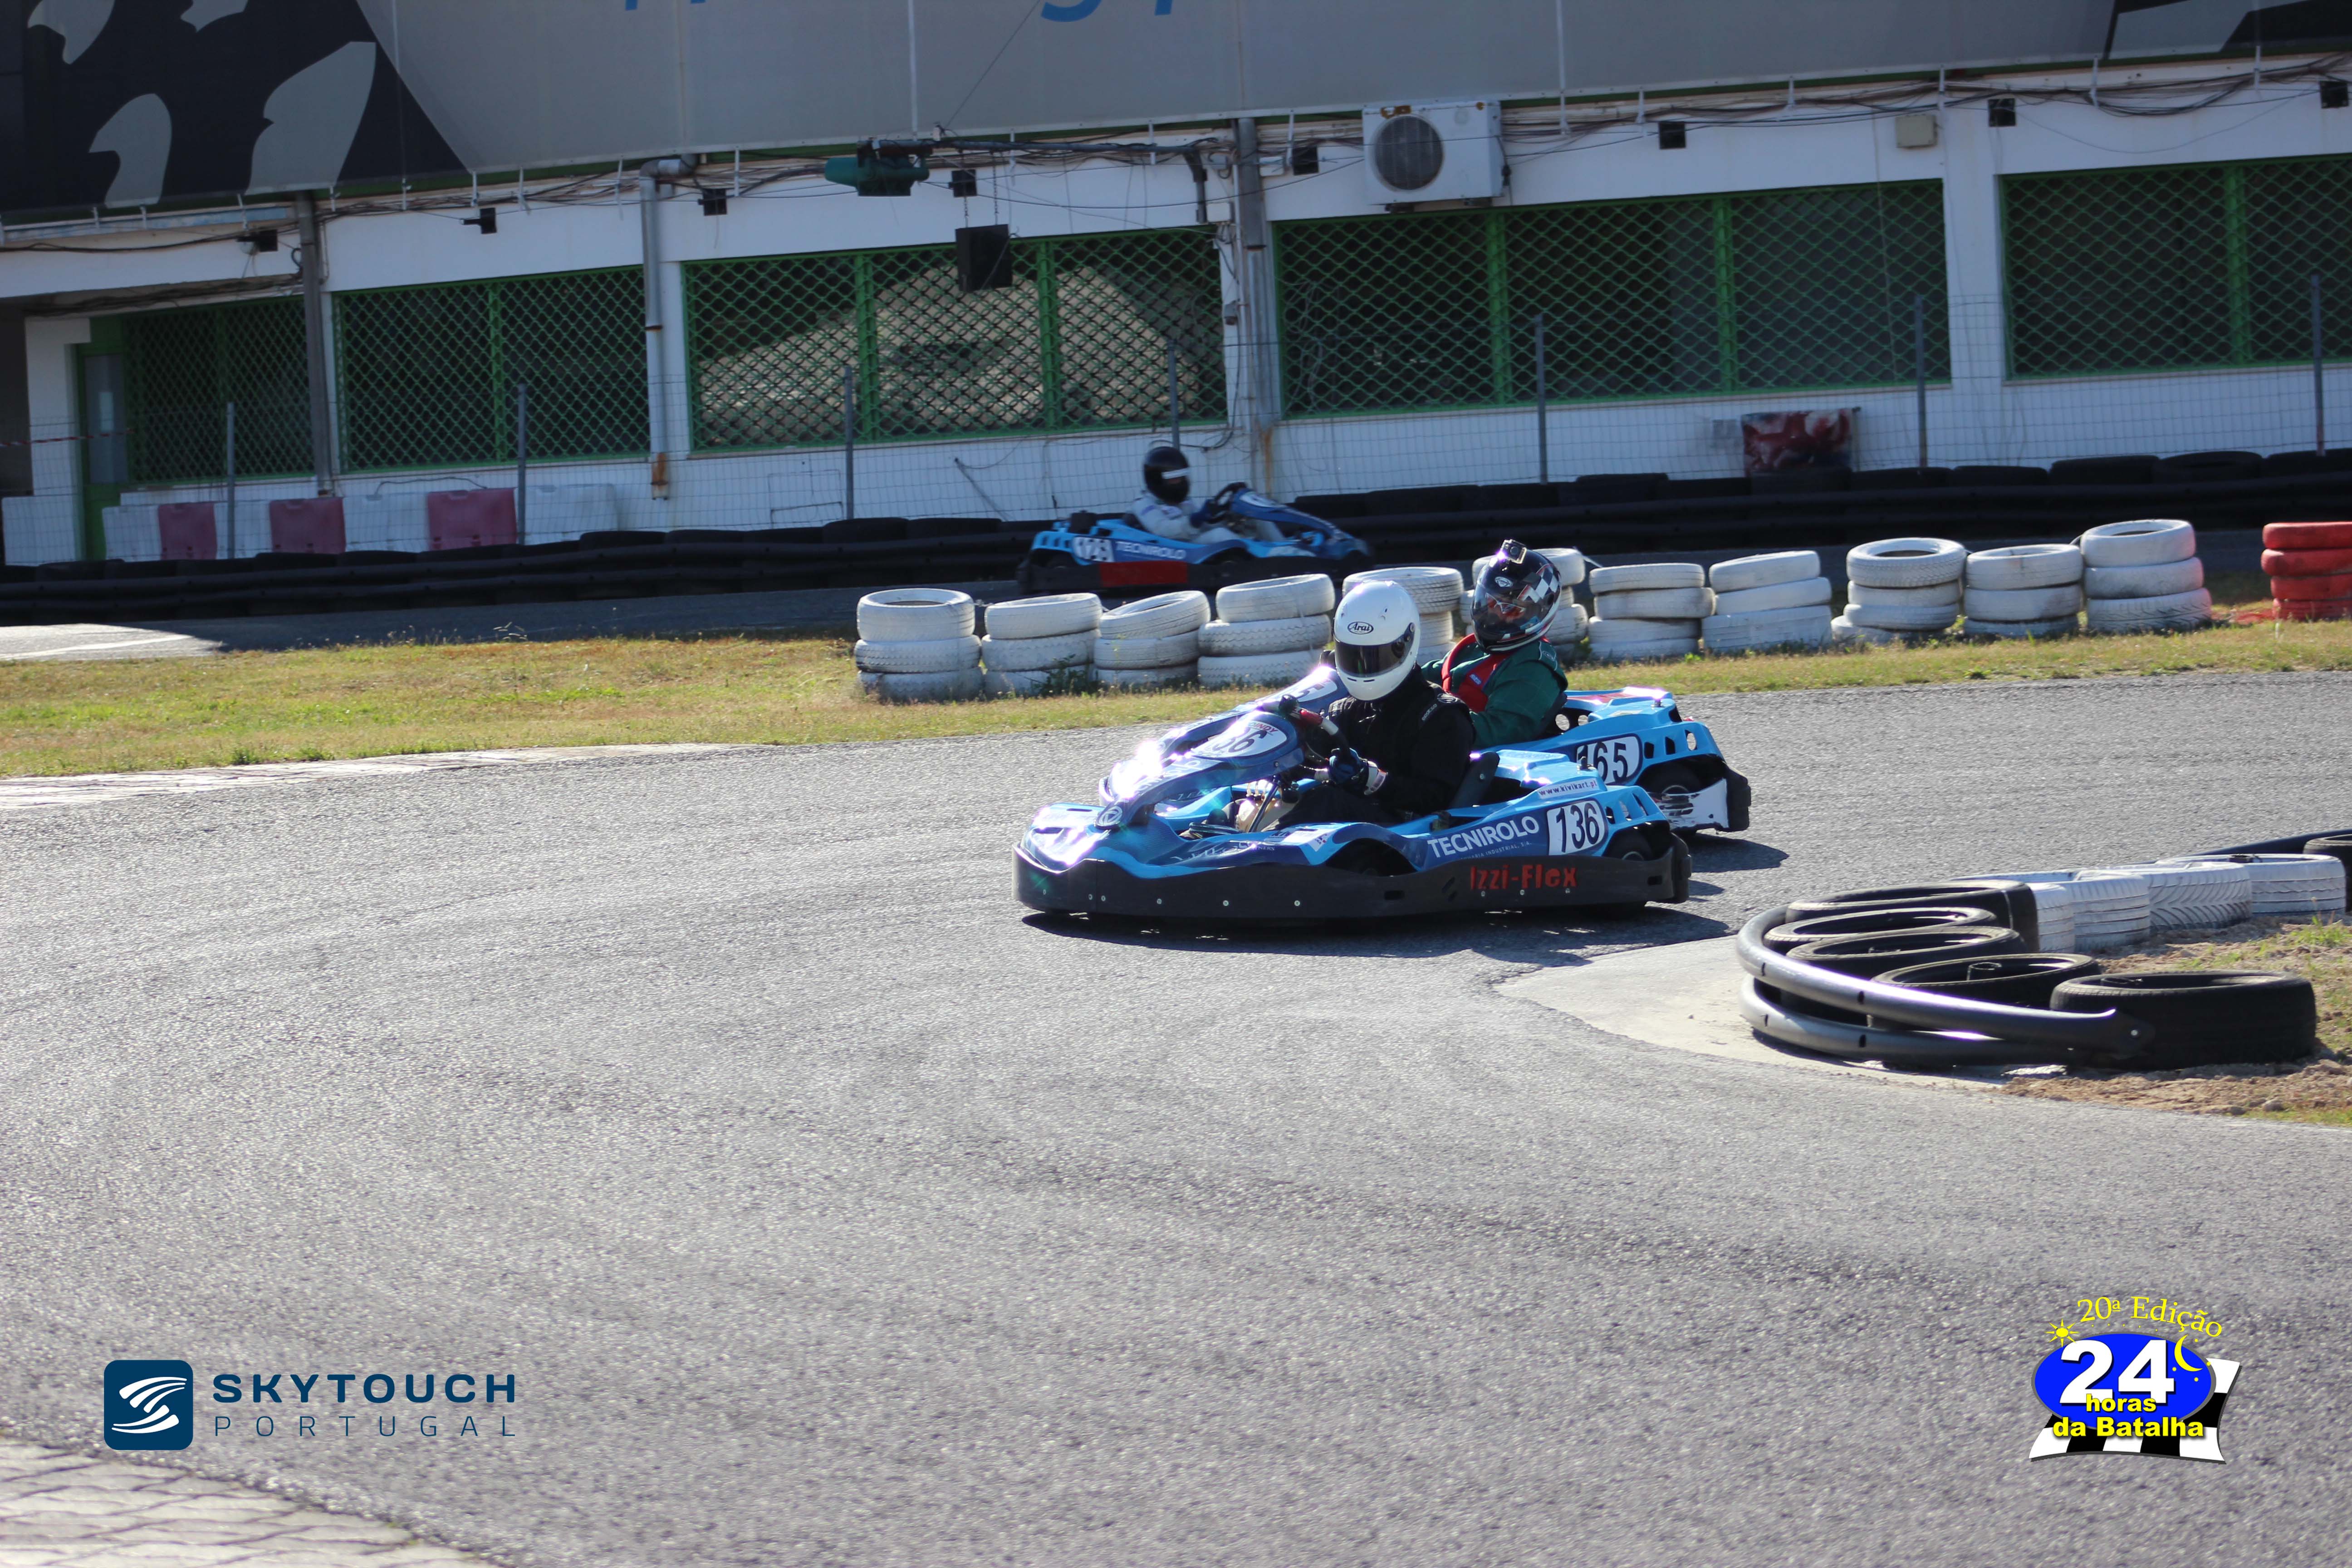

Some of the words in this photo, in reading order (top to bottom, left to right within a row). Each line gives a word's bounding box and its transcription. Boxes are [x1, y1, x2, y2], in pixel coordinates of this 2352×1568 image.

[1349, 622, 1370, 631] Arai
[1427, 816, 1539, 858] TECNIROLO
[1556, 803, 1599, 853] 136
[1470, 864, 1577, 890] Izzi-Flex
